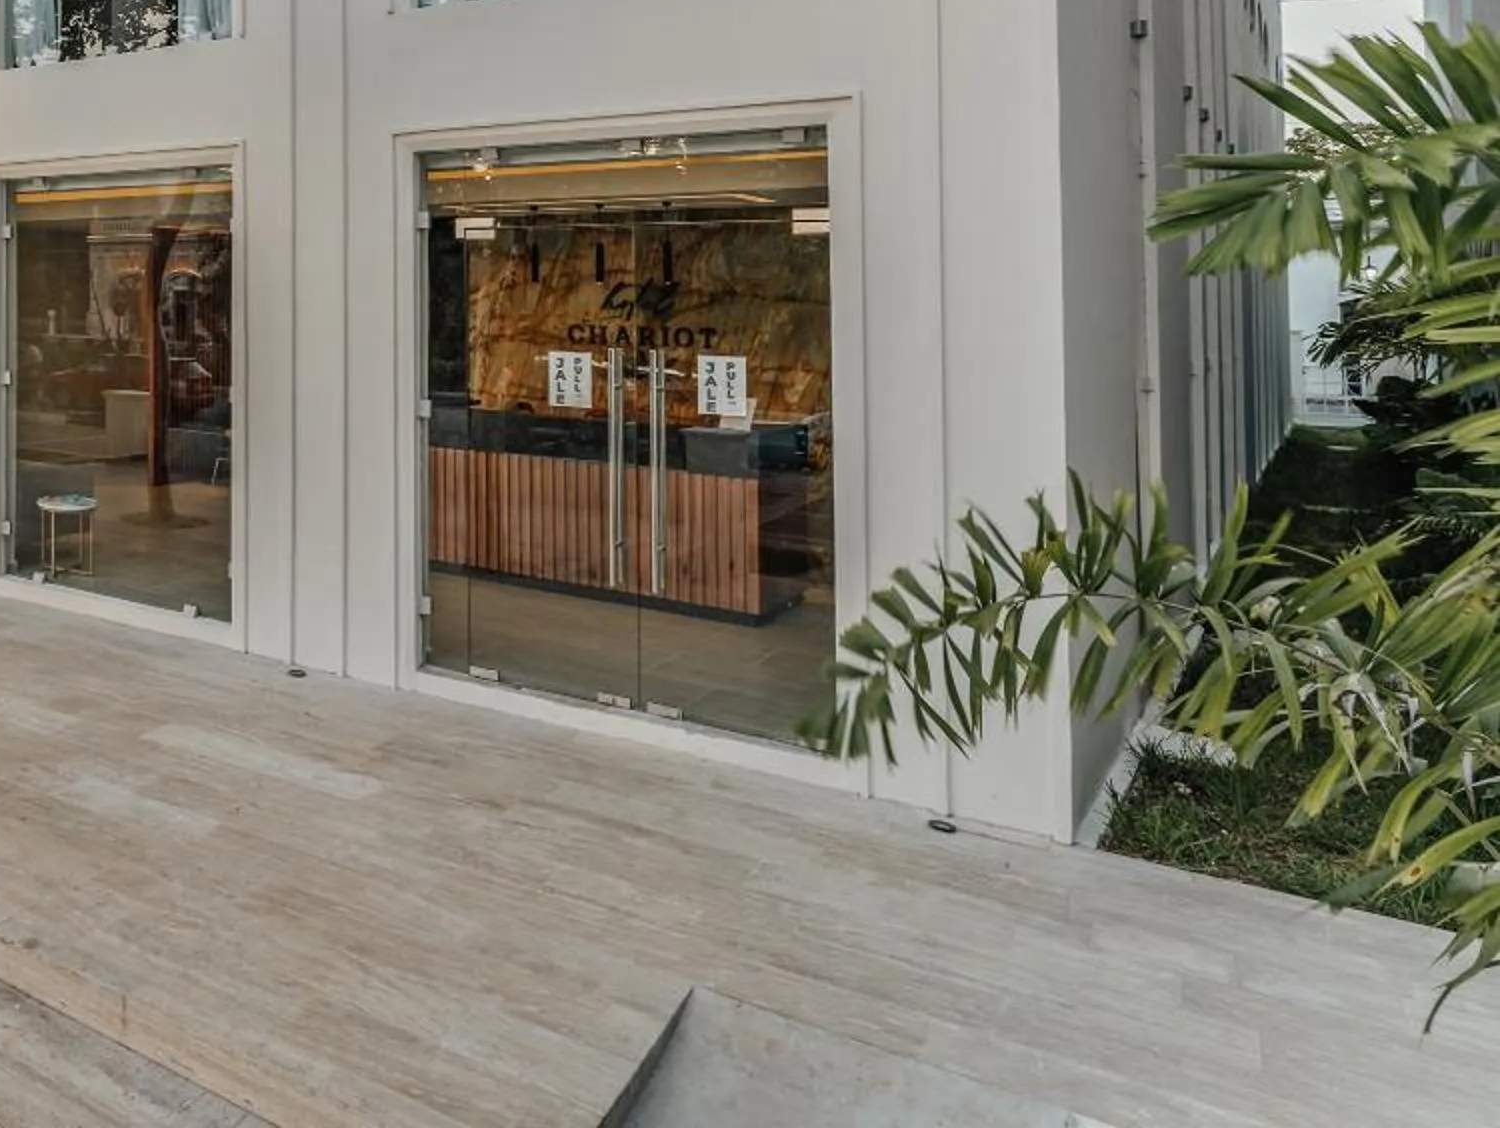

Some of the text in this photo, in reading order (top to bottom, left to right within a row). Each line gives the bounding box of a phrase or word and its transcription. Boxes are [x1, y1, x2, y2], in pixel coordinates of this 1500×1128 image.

[567, 324, 718, 349] CHARIOT
[555, 357, 566, 405] JALE
[573, 357, 583, 393] PULL
[705, 361, 717, 413] JALE
[726, 361, 736, 399] PULL
